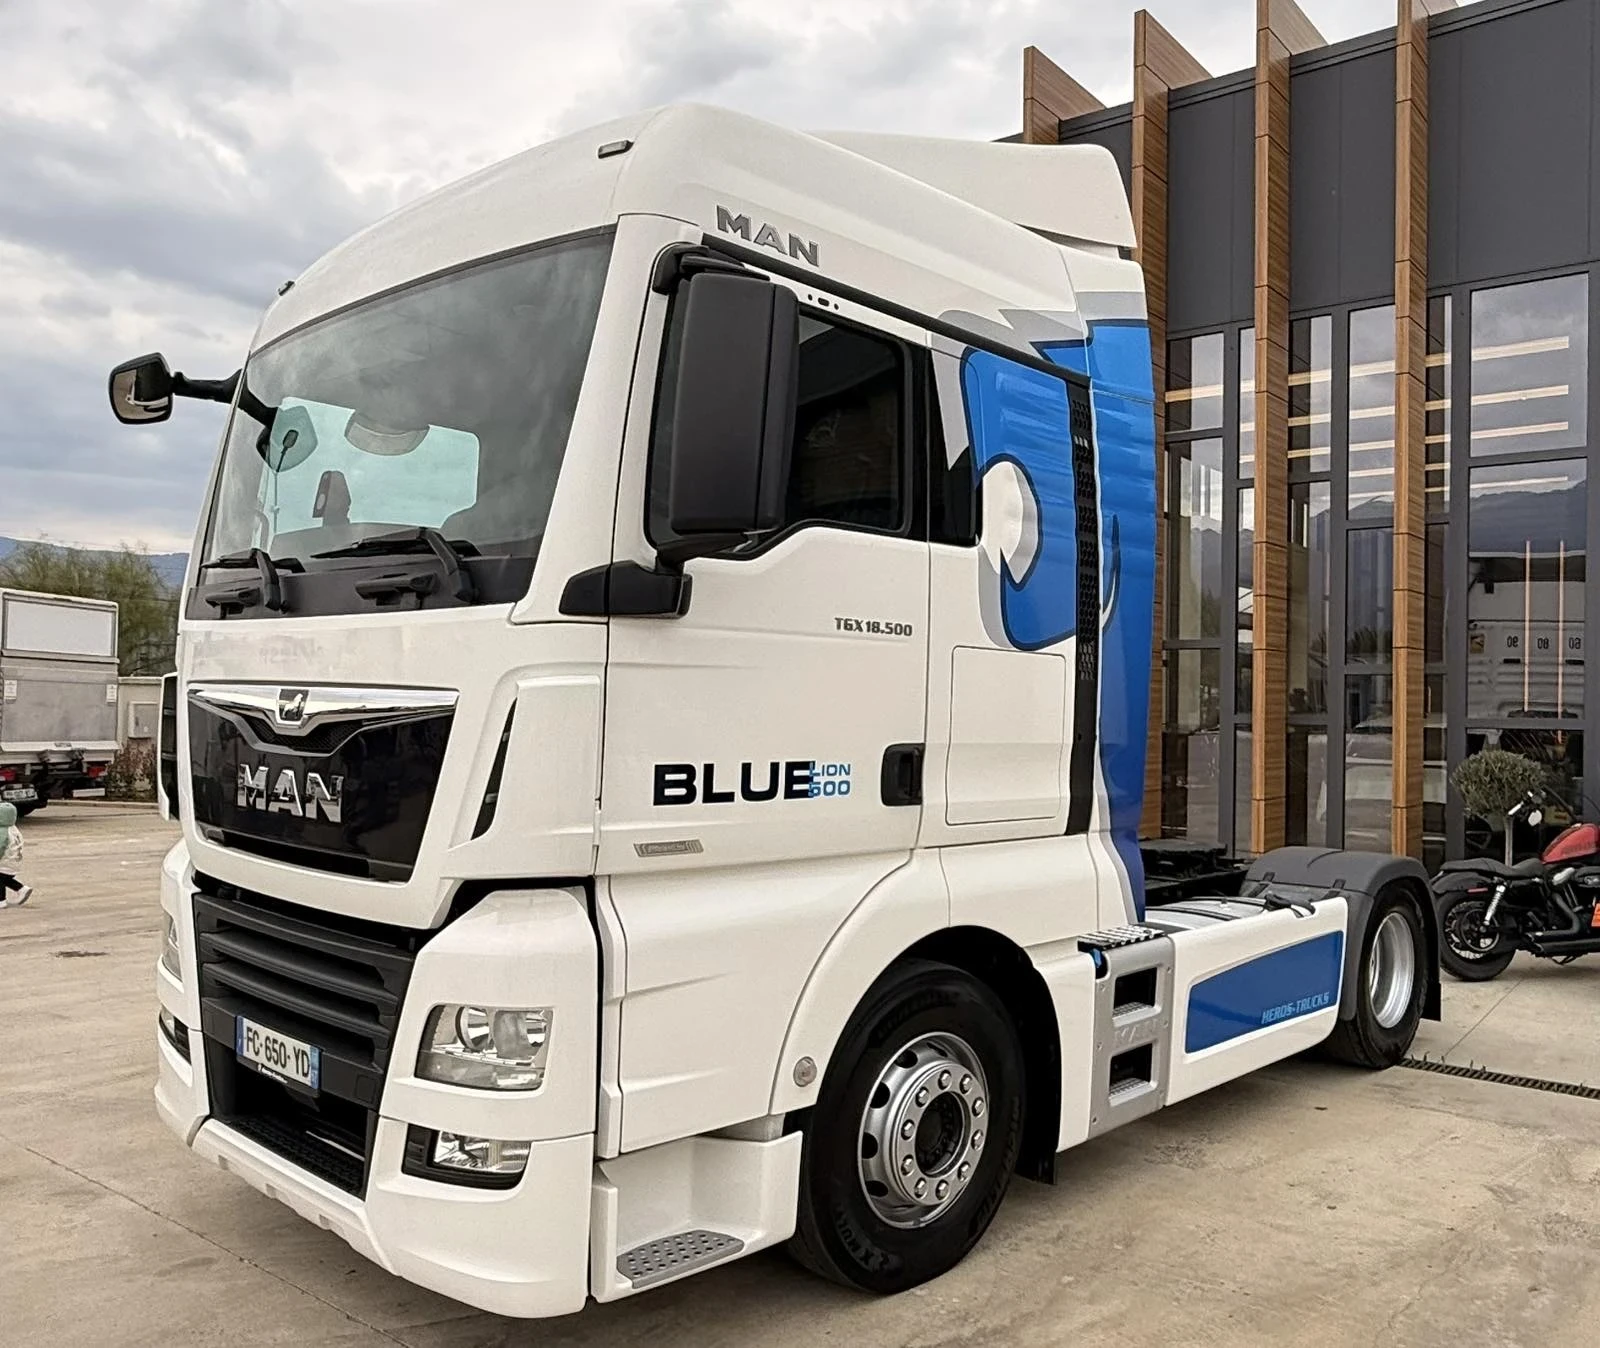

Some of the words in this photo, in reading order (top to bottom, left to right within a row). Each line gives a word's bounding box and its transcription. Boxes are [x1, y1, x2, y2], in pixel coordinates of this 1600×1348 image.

[716, 204, 819, 268] MAN
[237, 763, 344, 823] MAN
[653, 760, 816, 806] BLUE
